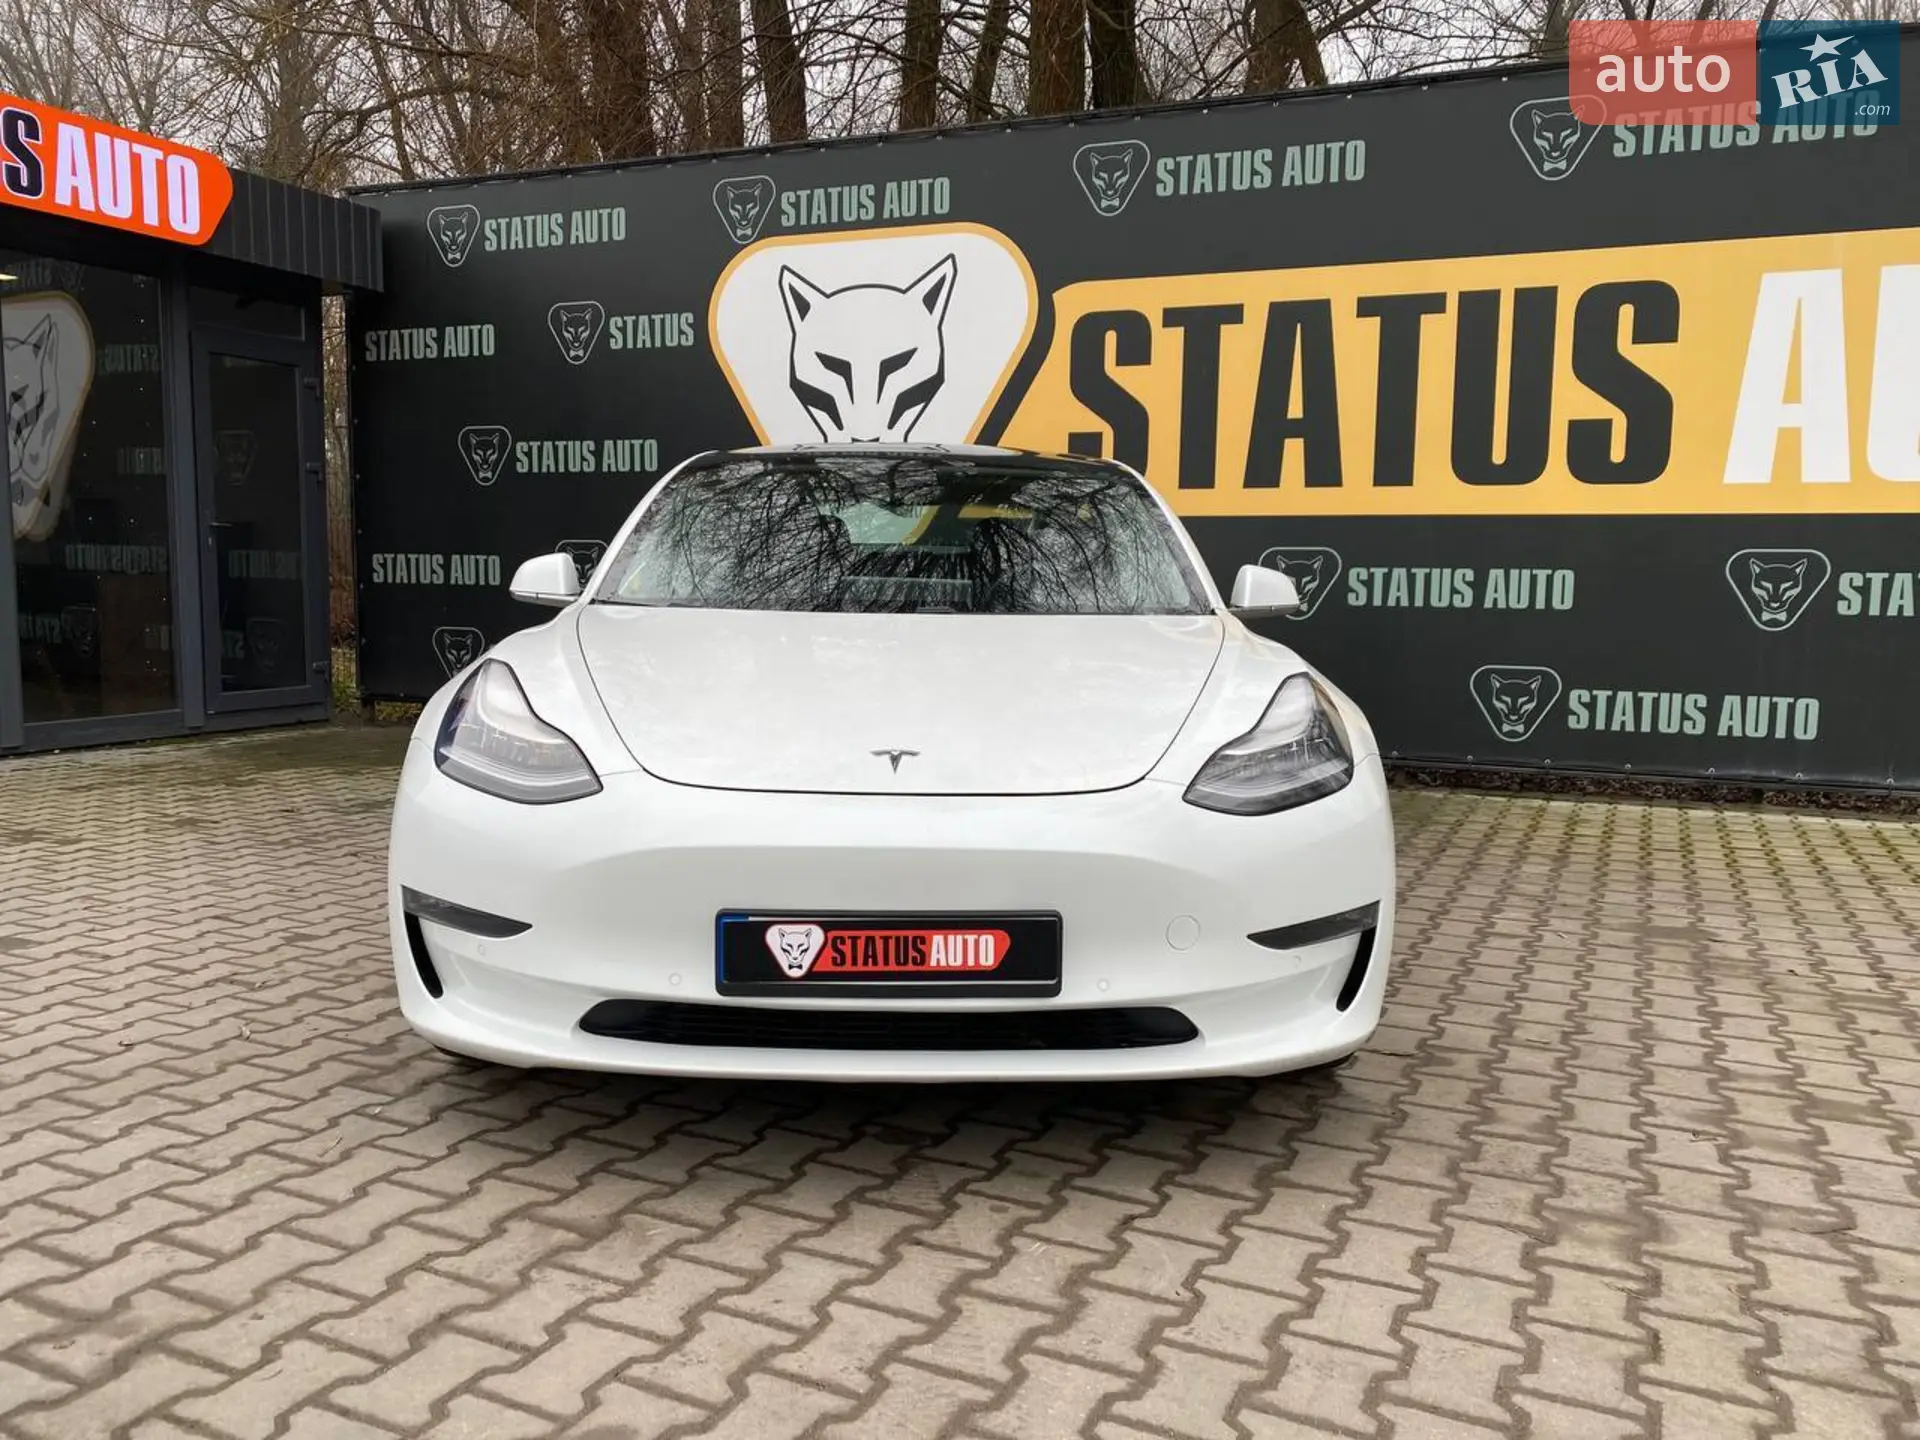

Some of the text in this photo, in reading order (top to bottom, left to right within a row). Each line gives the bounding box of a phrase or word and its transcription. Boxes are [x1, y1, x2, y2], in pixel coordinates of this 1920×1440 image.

[1613, 90, 1880, 158] STATUS AUTO
[54, 122, 200, 235] AUTO
[1156, 140, 1366, 197] STATUS AUTO
[781, 176, 951, 228] STATUS AUTO
[484, 207, 627, 251] STATUS AUTO
[365, 324, 496, 362] STATUS AUTO
[609, 312, 695, 350] STATUS
[1067, 282, 1681, 488] STATUS
[515, 439, 659, 473] STATUS AUTO
[371, 553, 501, 586] STATUS AUTO
[1347, 567, 1575, 610] STATUS AUTO
[1837, 572, 1920, 617] STA
[1567, 689, 1820, 740] STATUS AUTO
[831, 934, 995, 967] STATUS AUTO
